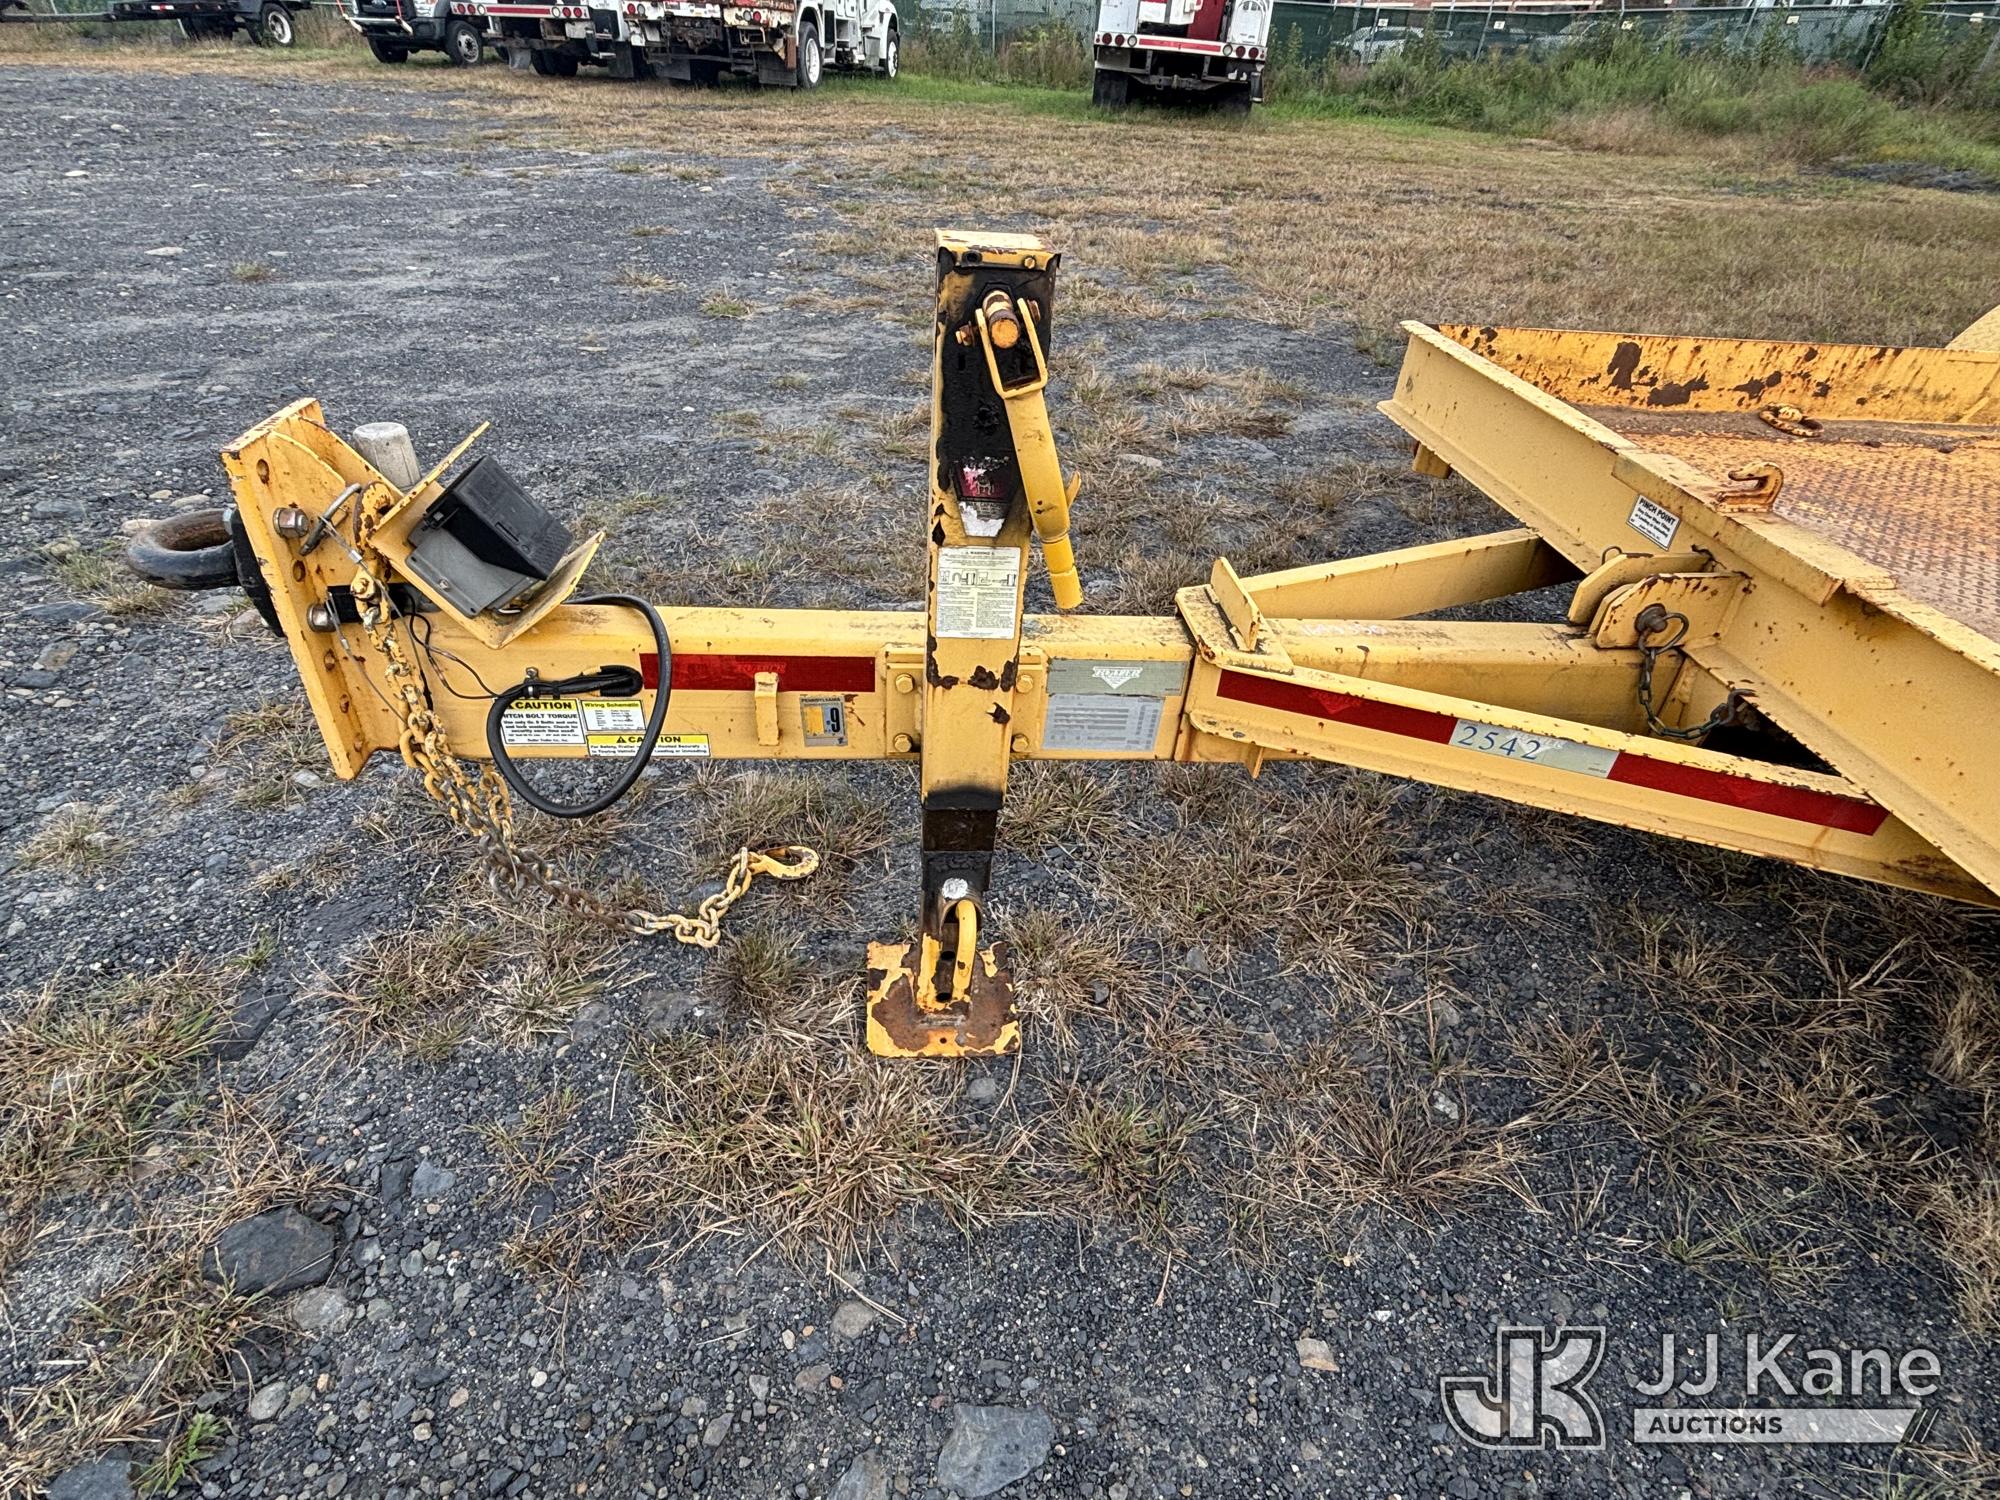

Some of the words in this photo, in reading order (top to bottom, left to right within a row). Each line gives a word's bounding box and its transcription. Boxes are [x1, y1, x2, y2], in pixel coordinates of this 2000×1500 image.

[1639, 498, 1657, 513] PINCH
[1657, 509, 1676, 525] POINT
[830, 707, 841, 733] 9
[1457, 725, 1541, 761] 2542
